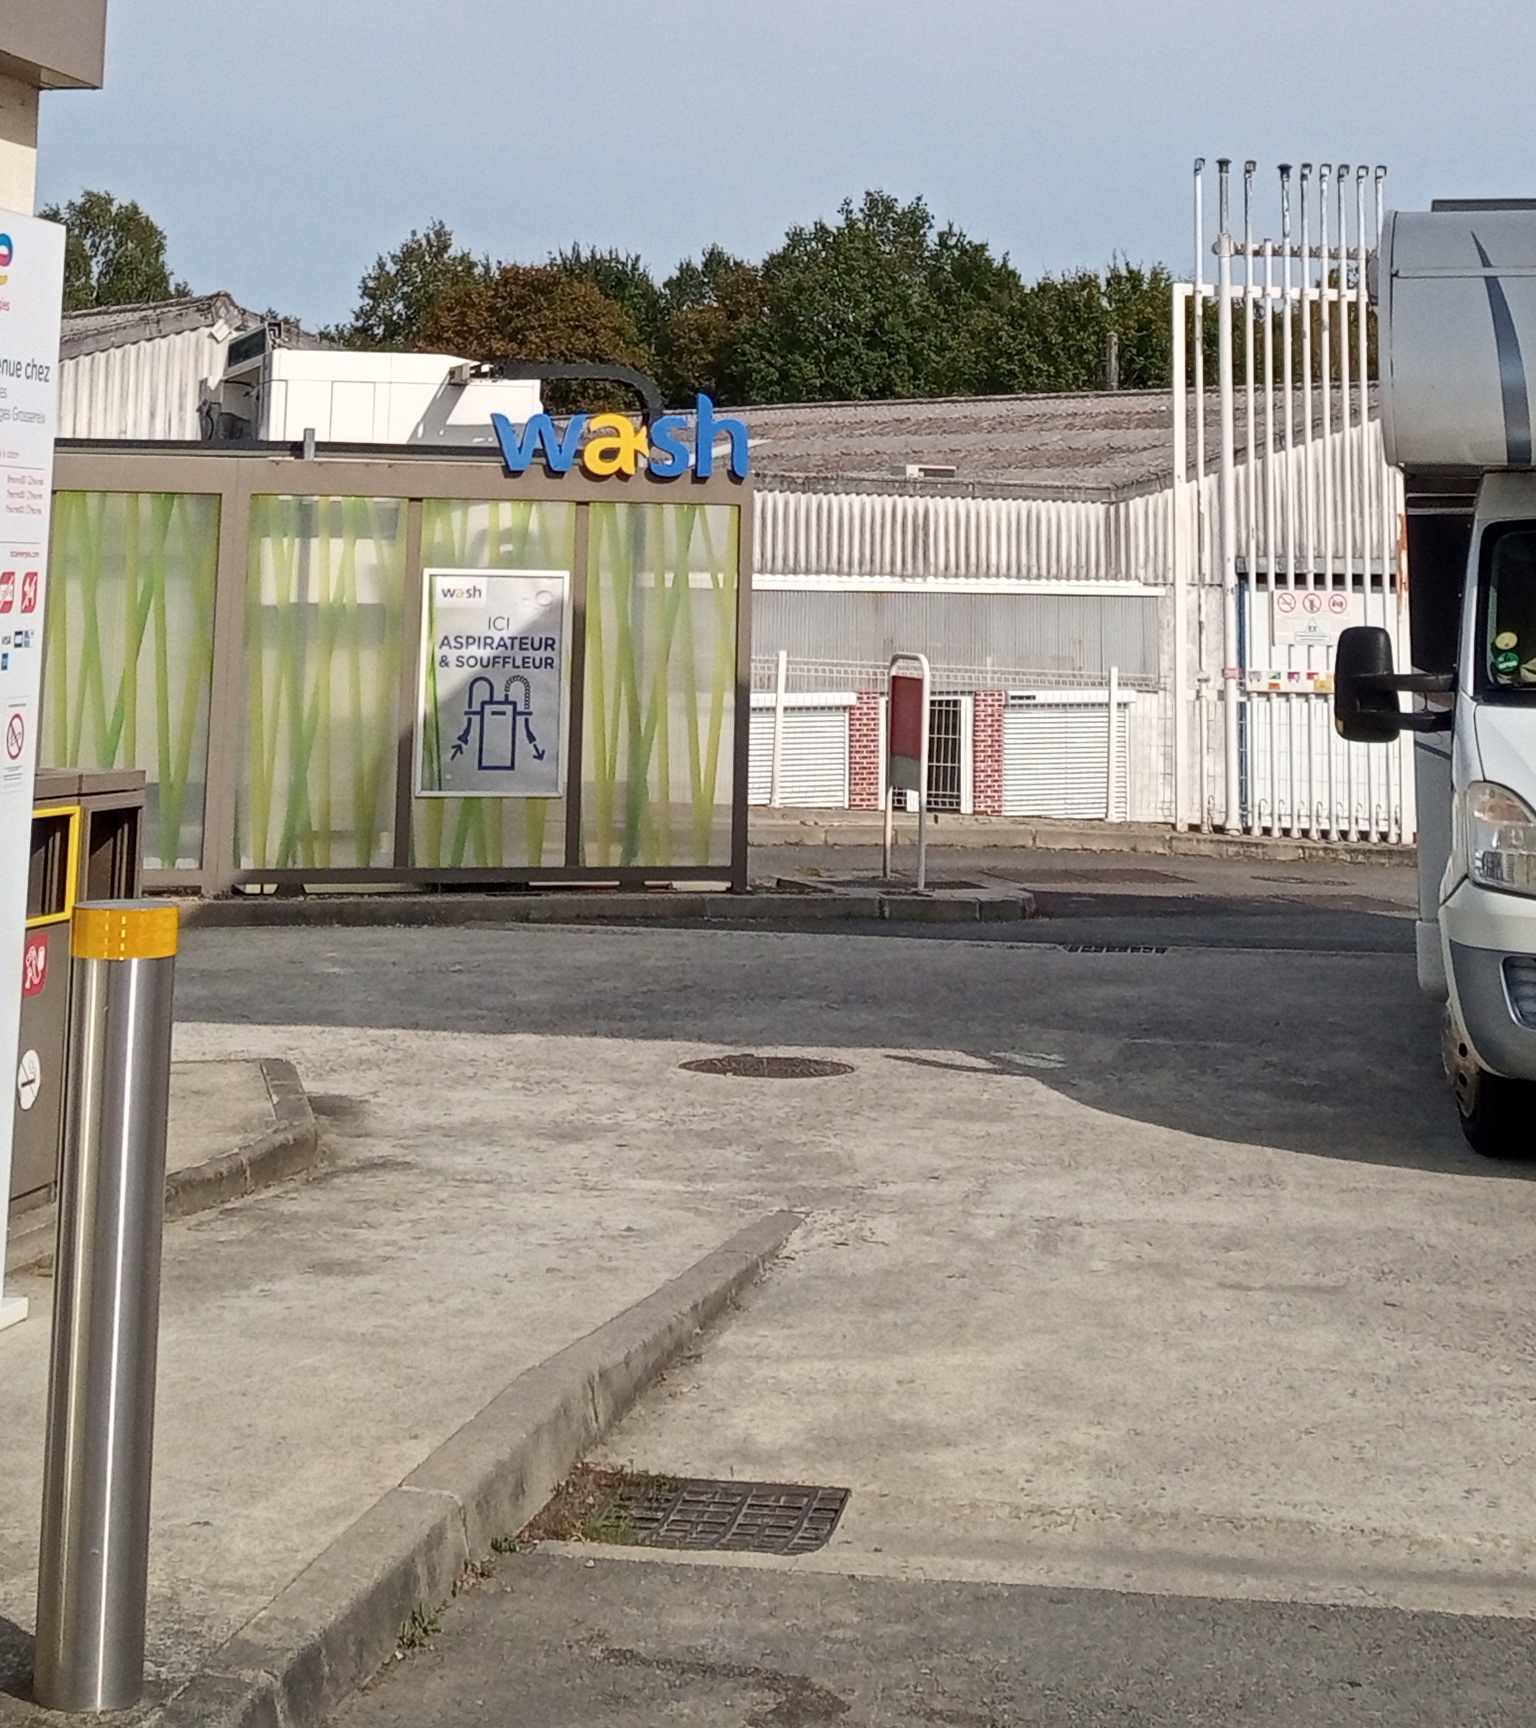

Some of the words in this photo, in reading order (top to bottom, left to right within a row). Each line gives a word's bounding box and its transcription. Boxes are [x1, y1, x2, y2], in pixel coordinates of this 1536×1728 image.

[24, 357, 51, 383] chez
[490, 392, 751, 478] wash
[441, 586, 482, 599] wash
[487, 616, 511, 632] ICI
[438, 635, 556, 652] ASPIRATEUR
[438, 655, 451, 669] &
[455, 655, 555, 670] SOUFFLEUR
